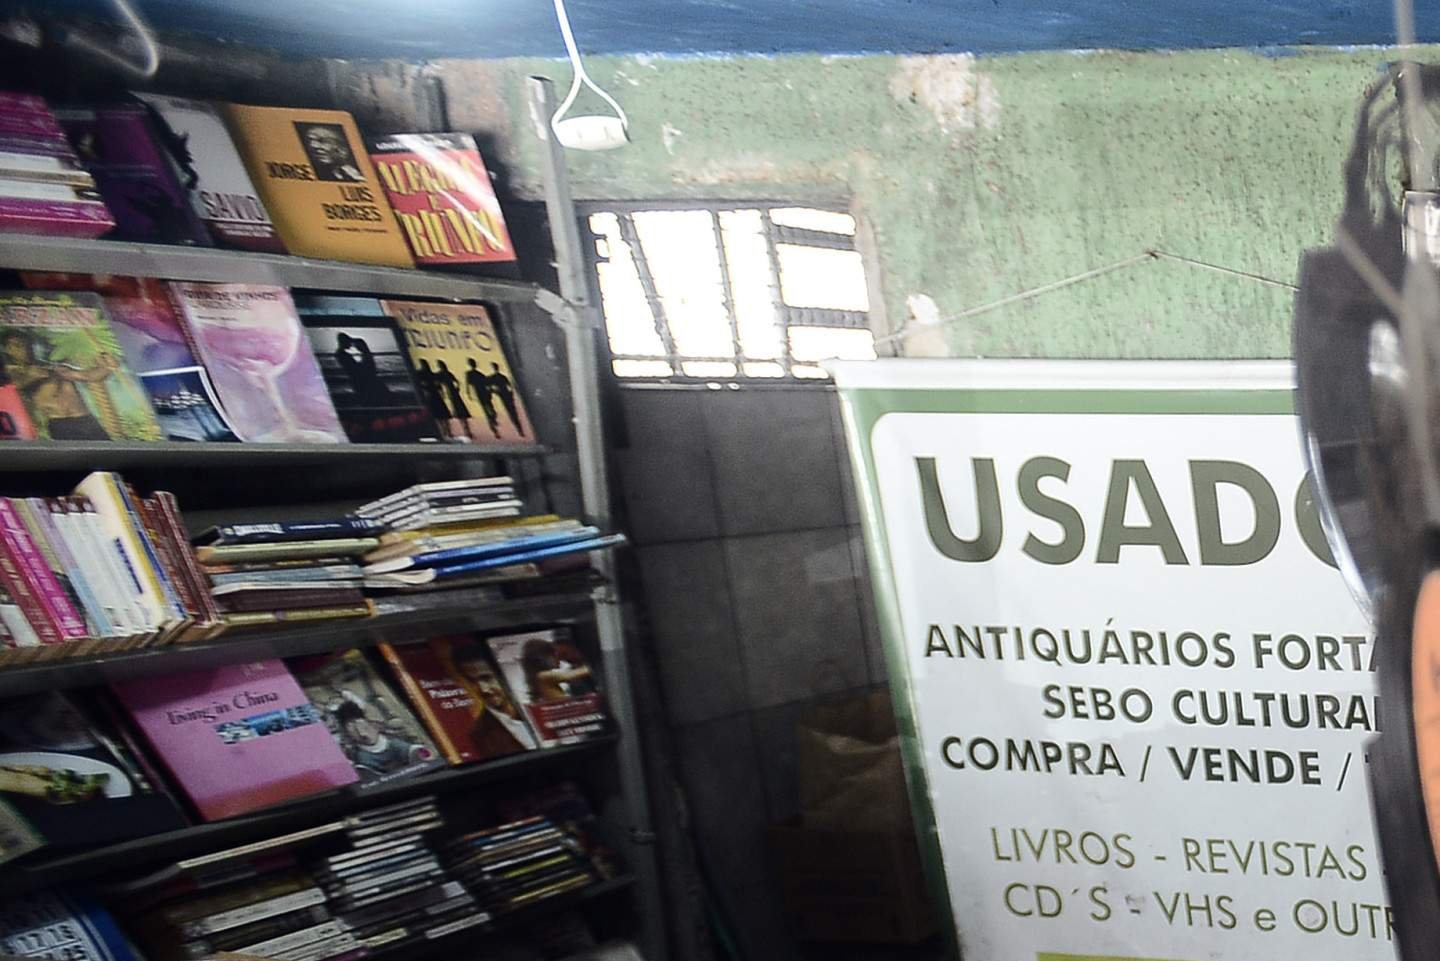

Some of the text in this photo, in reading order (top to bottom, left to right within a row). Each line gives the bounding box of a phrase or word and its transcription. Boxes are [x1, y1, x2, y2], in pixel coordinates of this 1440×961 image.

[267, 161, 315, 181] JORGE
[323, 204, 383, 223] BORGES
[340, 186, 373, 203] LUIS
[925, 618, 1237, 668] ANTIQUÁRIOS
[166, 701, 214, 726] Living
[232, 690, 278, 710] China
[1042, 684, 1154, 724] SEBO
[941, 737, 1126, 777] COMPRA
[1167, 747, 1322, 785] VENDE
[991, 827, 1136, 869] LIVROS
[1183, 837, 1368, 881] REVISTAS
[1154, 890, 1237, 931] VHS
[1253, 908, 1277, 932] e
